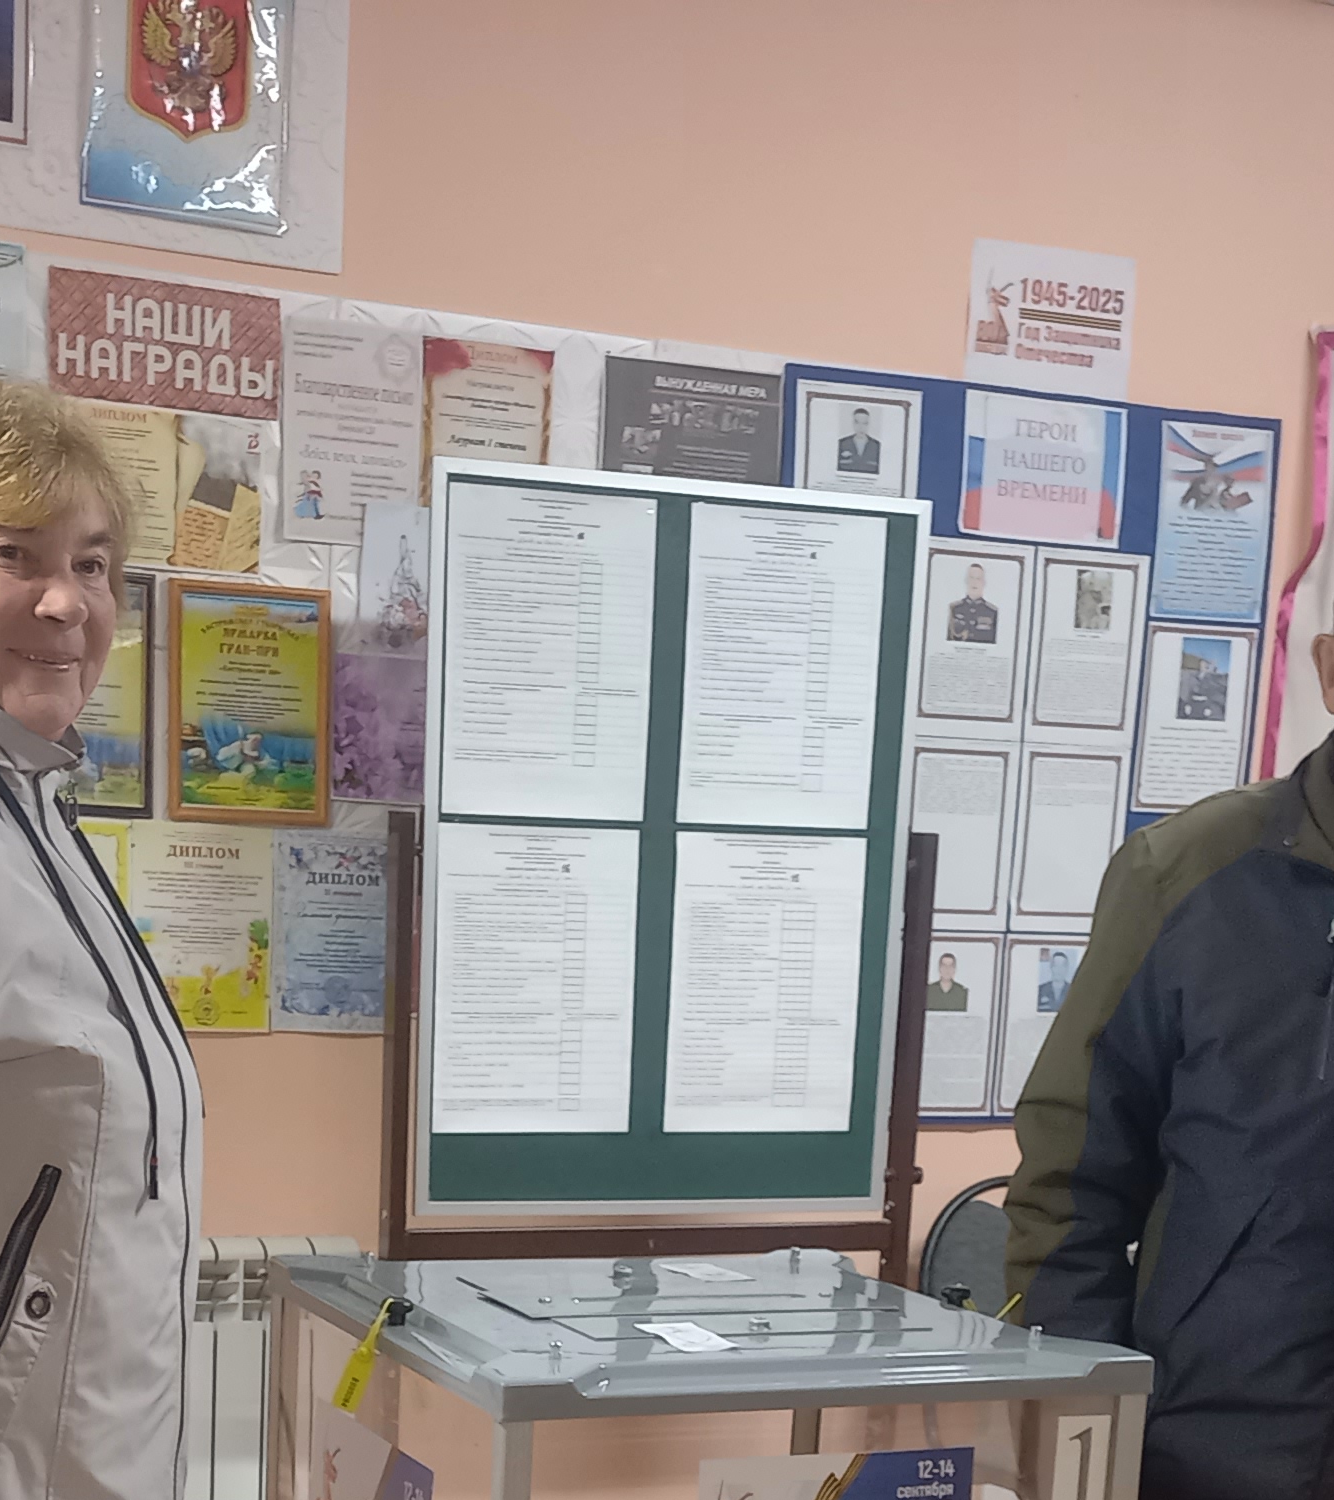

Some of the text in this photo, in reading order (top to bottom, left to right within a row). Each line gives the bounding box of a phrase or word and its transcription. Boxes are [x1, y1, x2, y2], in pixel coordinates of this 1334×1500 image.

[1020, 277, 1124, 315] 1945-2025
[105, 292, 231, 350] НАШИ
[56, 332, 274, 400] НАГРАДЫ
[1014, 418, 1077, 443] ГЕРОИ
[1002, 449, 1087, 475] НАШЕГО
[997, 479, 1087, 506] ВРЕМЕНИ
[167, 844, 241, 861] ДИПЛОМ
[305, 871, 381, 888] ДИПЛОМ
[917, 1459, 955, 1479] 12-14
[896, 1482, 954, 1500] сентября
